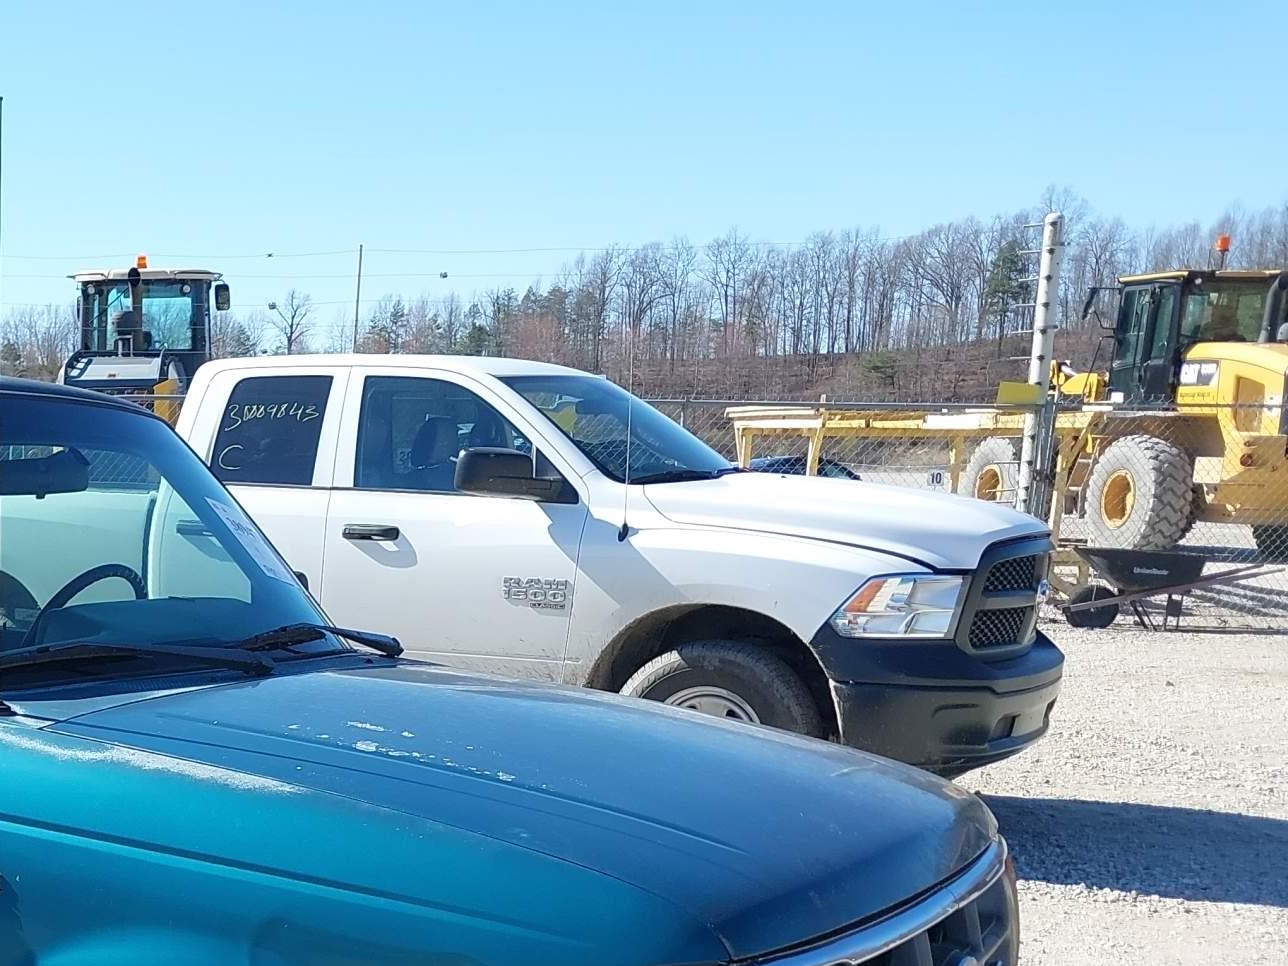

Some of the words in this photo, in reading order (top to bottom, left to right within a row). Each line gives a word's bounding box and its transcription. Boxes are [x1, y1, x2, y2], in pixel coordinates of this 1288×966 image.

[219, 445, 244, 470] C
[931, 471, 942, 484] 10
[503, 576, 568, 590] RAM
[503, 588, 567, 602] 1500
